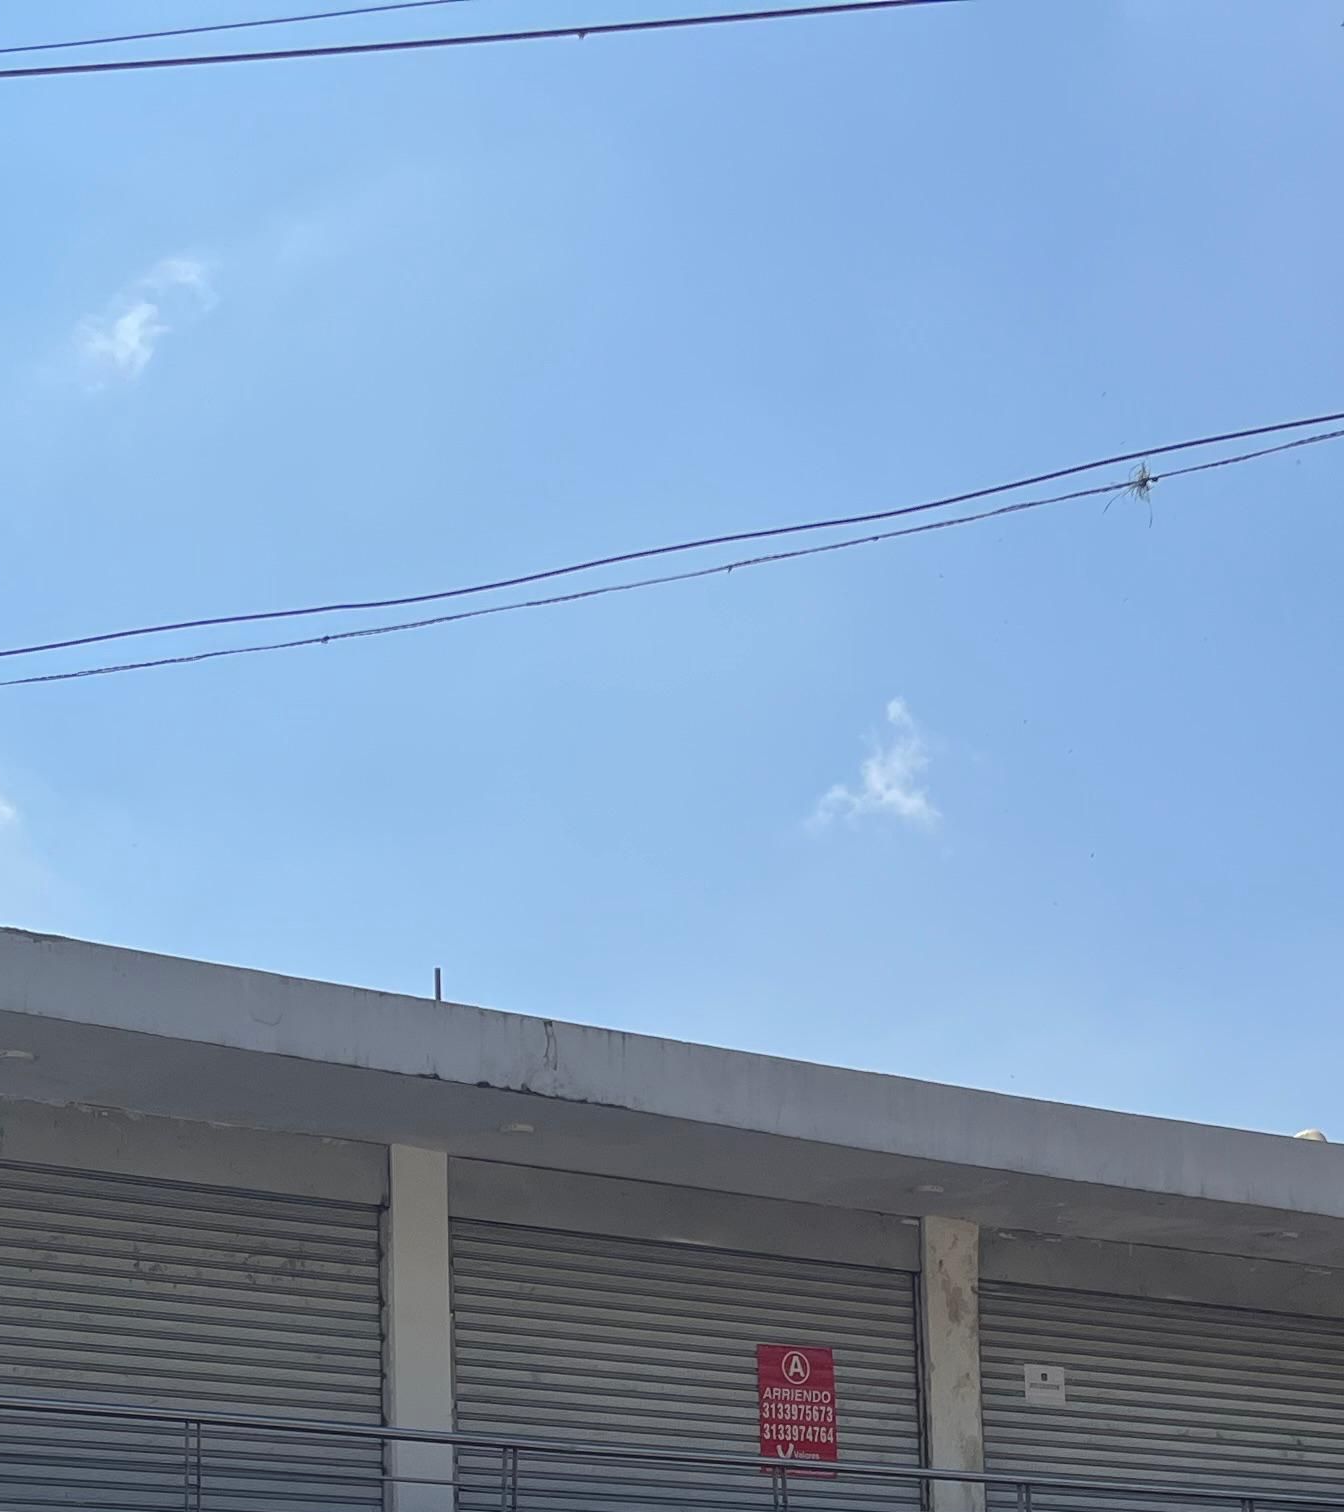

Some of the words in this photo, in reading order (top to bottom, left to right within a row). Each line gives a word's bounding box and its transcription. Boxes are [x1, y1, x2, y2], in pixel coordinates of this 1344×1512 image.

[788, 1355, 805, 1378] A
[762, 1387, 831, 1403] ARRIENDO
[762, 1402, 833, 1423] 3133975673
[763, 1423, 834, 1444] 3133974764
